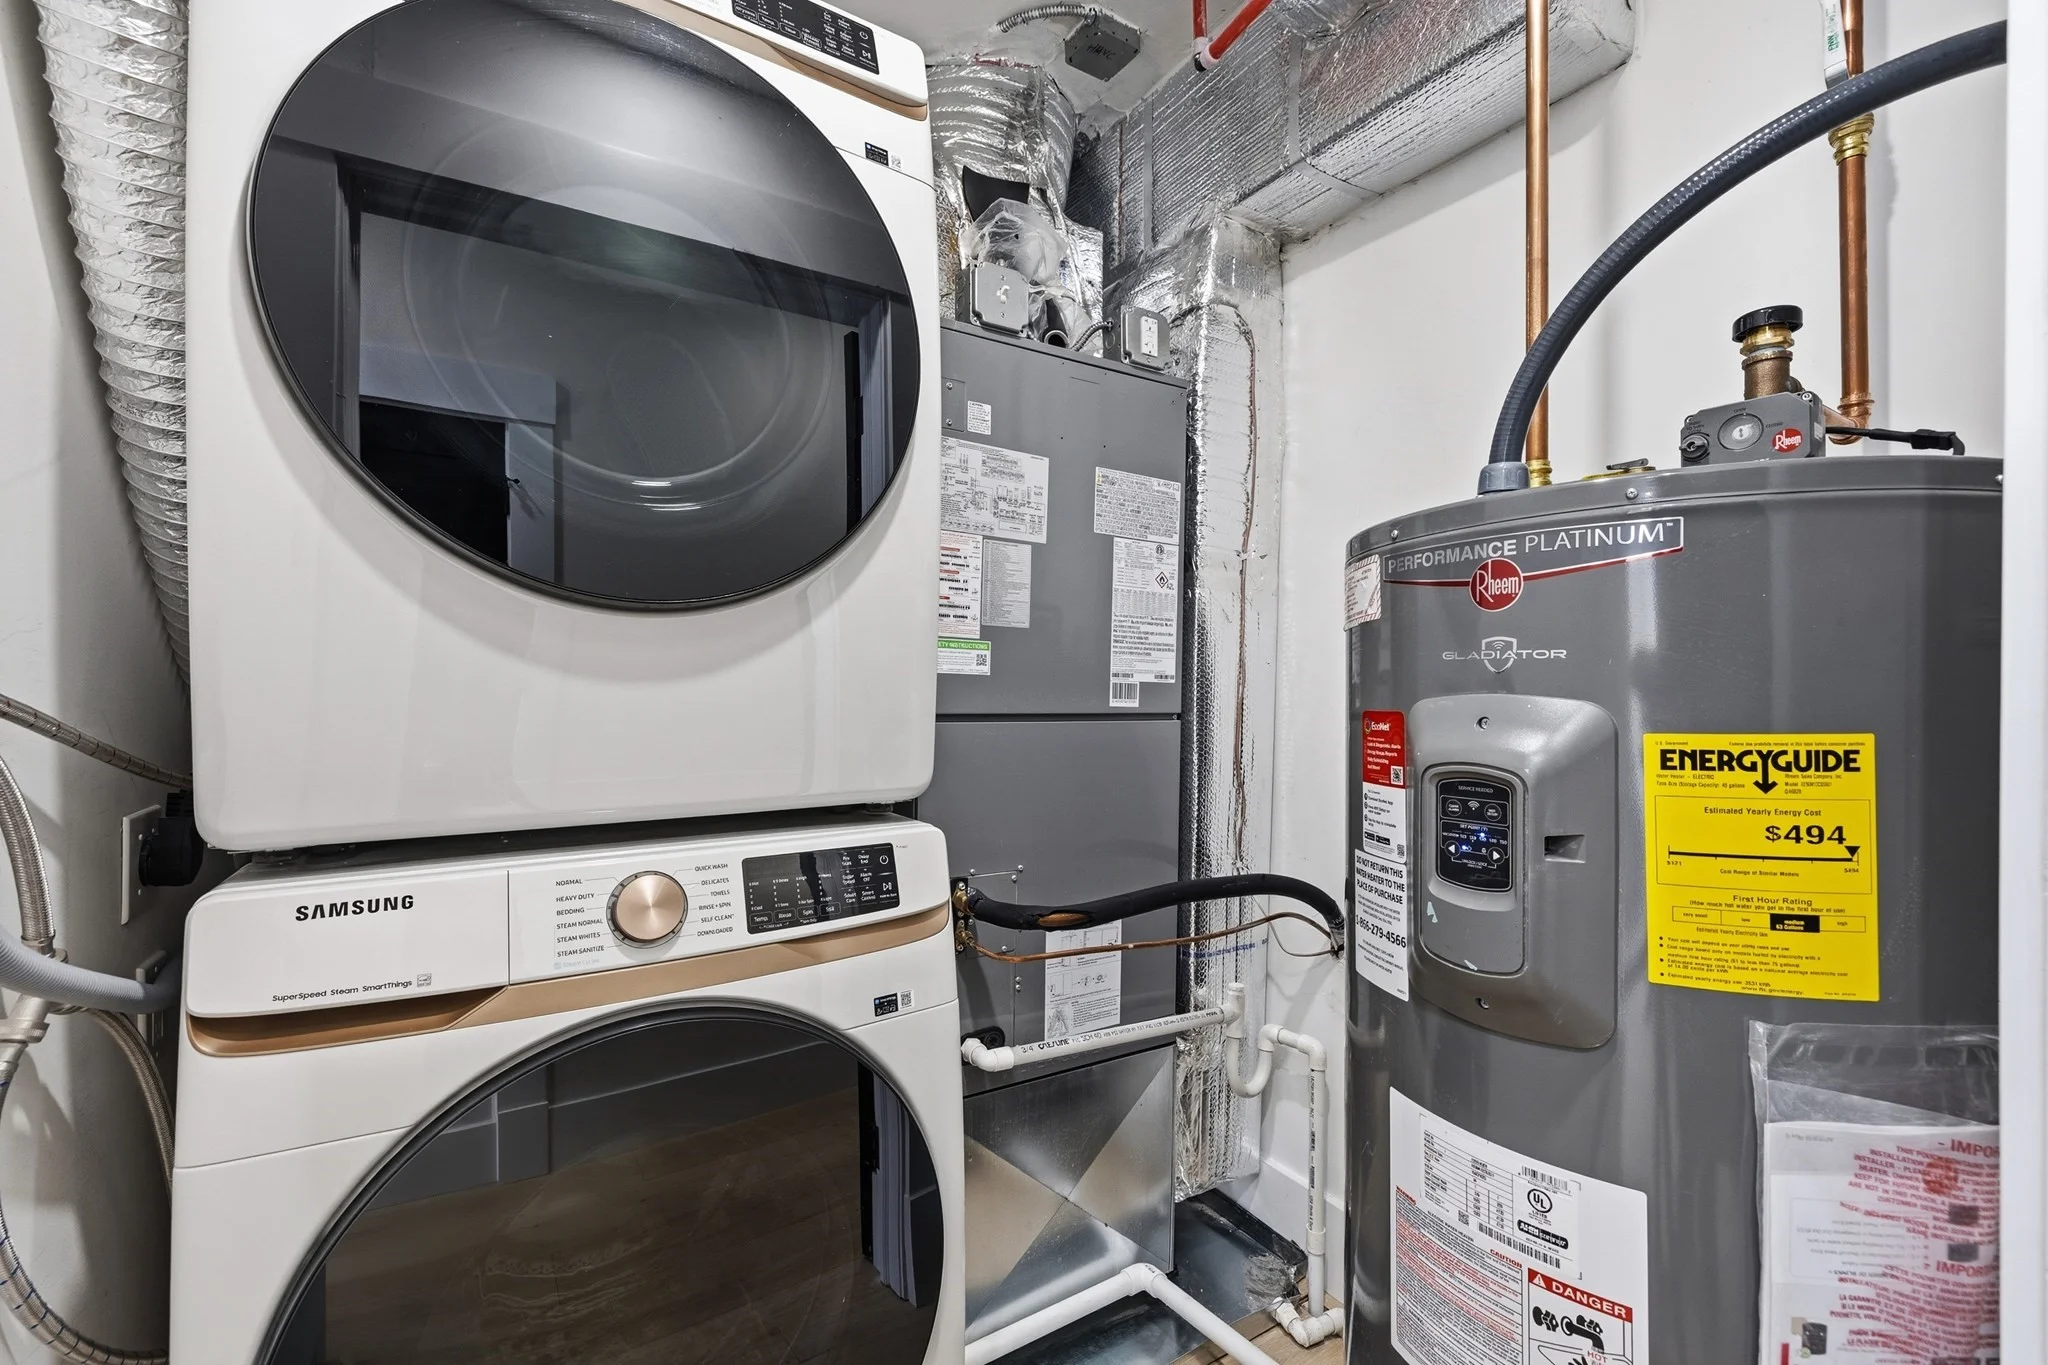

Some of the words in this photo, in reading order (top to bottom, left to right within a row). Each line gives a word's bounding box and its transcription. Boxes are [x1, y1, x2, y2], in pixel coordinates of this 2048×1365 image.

[1774, 430, 1801, 450] Rheem
[1388, 539, 1517, 573] PERFORMANCE
[1475, 559, 1519, 602] Rheem
[1442, 649, 1567, 660] GLADIATOR
[1660, 749, 1861, 773] ENERGYGUIDE
[1704, 806, 1743, 815] Estimated
[1746, 808, 1772, 816] Yearly
[1774, 808, 1802, 817] Energy
[1765, 824, 1847, 844] $494
[694, 864, 712, 872] QUICK
[1370, 861, 1389, 874] RETURN
[1390, 867, 1403, 878] THIS
[555, 878, 583, 886] NORMAL
[701, 877, 730, 886] DELICATES
[1367, 871, 1384, 886] HEATER
[1385, 878, 1392, 888] TO
[1393, 881, 1405, 892] THE
[556, 894, 577, 902] HEAVY
[710, 889, 730, 897] TOWELS
[1374, 886, 1403, 904] PURCHASE
[1733, 894, 1754, 903] First
[1757, 896, 1779, 904] Hour
[1782, 897, 1813, 907] Rating
[295, 895, 414, 922] SAMSUNG
[556, 907, 585, 916] BEDDING
[698, 903, 715, 911] RINSE
[556, 921, 577, 929] STEAM
[578, 918, 604, 927] NORMAL
[556, 935, 578, 943] STEAM
[578, 931, 601, 940] WHITES
[696, 926, 734, 937] DOWNLOADED
[1355, 914, 1407, 949] 1-866-279-4566
[557, 949, 578, 957] STEAM
[578, 944, 605, 954] SANITIZE
[272, 989, 327, 1002] SuperSpeed
[330, 986, 359, 996] Steam
[362, 980, 413, 992] SmartThings
[1854, 1153, 1895, 1169] INSTALLER
[1869, 1148, 1925, 1167] INSTALLATION
[1848, 1180, 1861, 1189] ARE
[1865, 1183, 1879, 1192] NOT
[1892, 1189, 1908, 1198] THIS
[1854, 1172, 1872, 1182] KEEP
[1874, 1176, 1889, 1185] FOR
[1892, 1180, 1920, 1191] FUTURE
[1533, 1192, 1547, 1209] UL
[1877, 1195, 1917, 1208] CUSTOMER
[1490, 1249, 1523, 1269] CAUTION
[1552, 1281, 1626, 1318] DANGER
[1849, 1295, 1882, 1306] GARANTIE
[1884, 1301, 1893, 1309] ET
[1857, 1304, 1876, 1312] MODE
[1587, 1350, 1608, 1364] HOT
